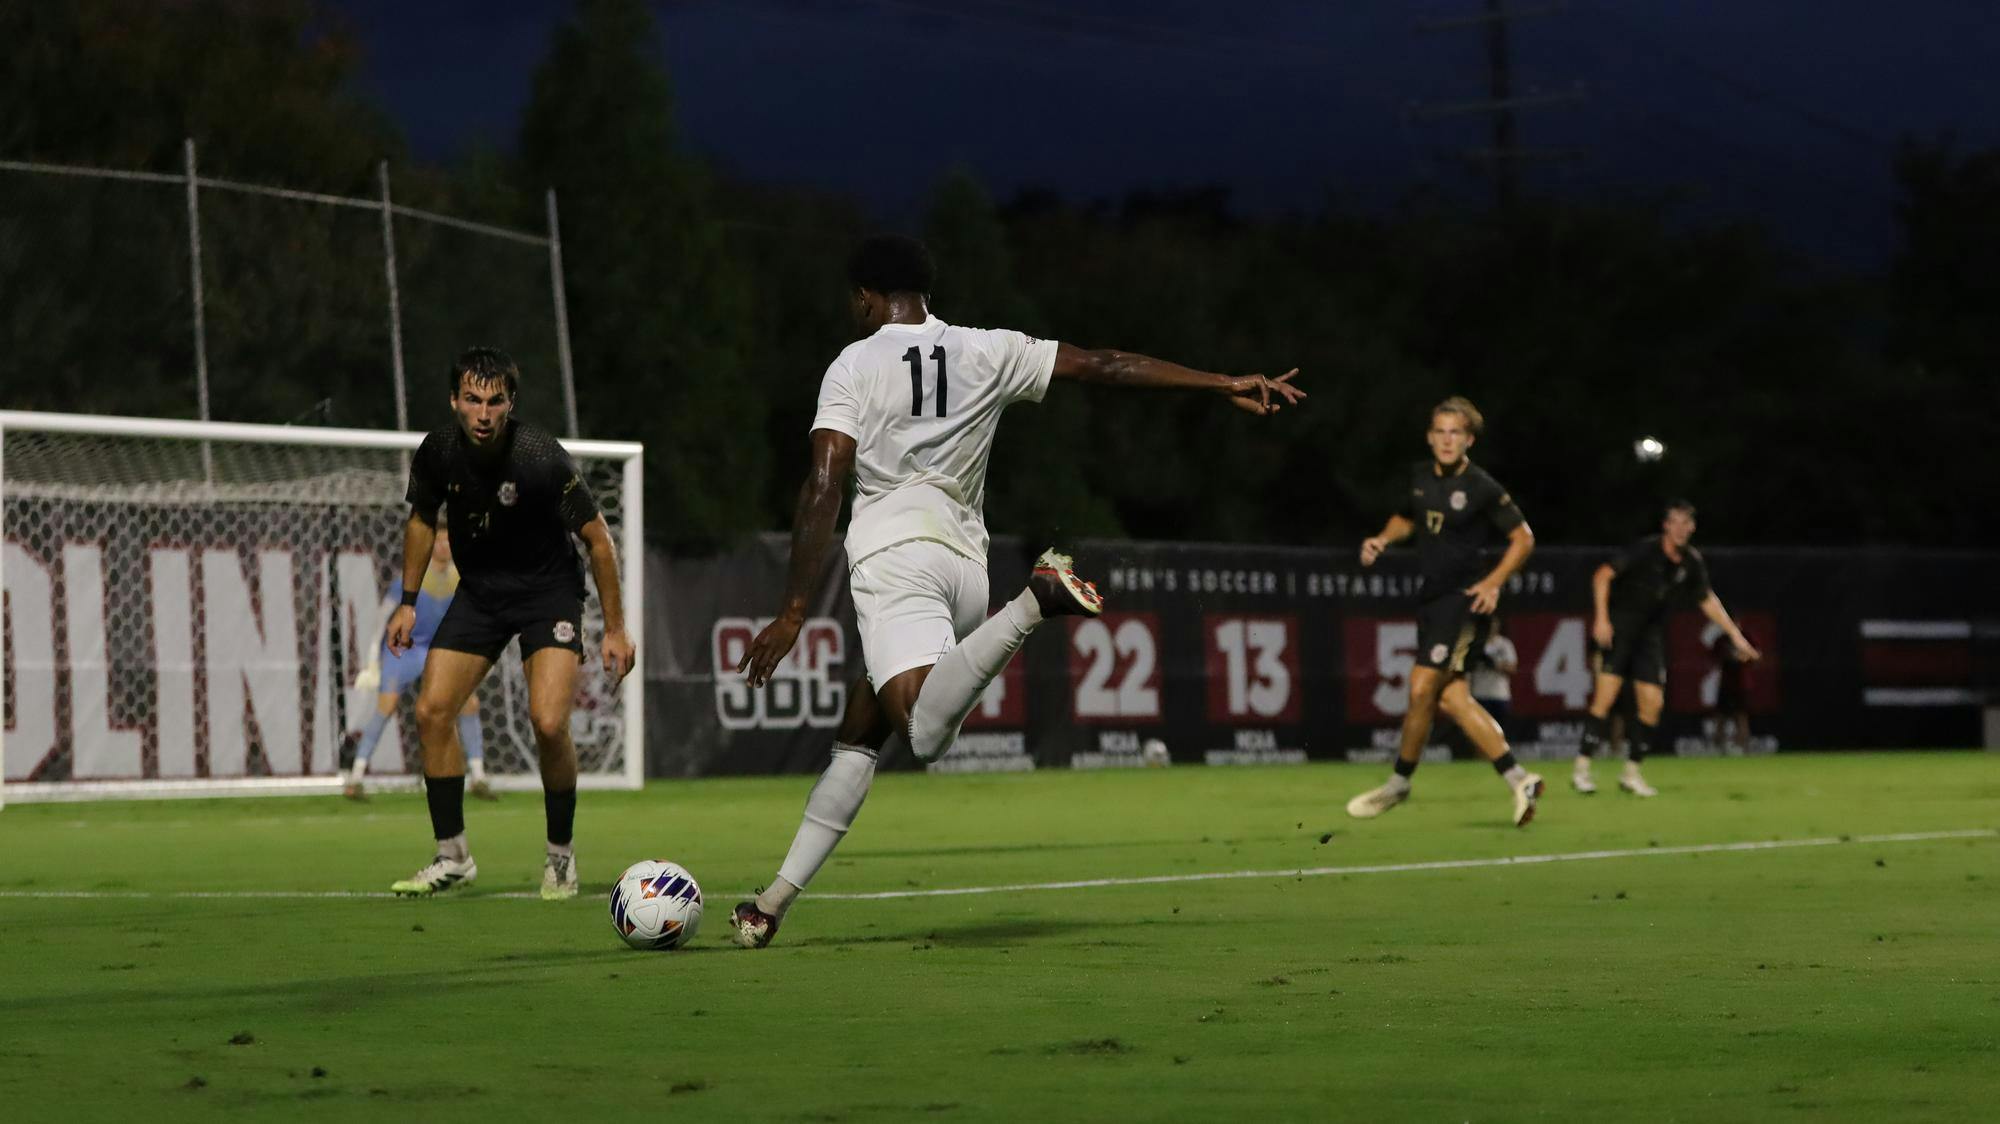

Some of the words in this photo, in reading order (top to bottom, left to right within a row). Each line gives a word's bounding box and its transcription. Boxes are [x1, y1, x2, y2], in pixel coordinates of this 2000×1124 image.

[902, 344, 948, 417] 11
[1426, 509, 1445, 535] 17
[1109, 567, 1178, 592] MEN'S
[1187, 568, 1277, 594] SOCCER
[1073, 618, 1161, 717] 22
[1215, 618, 1292, 718] 13
[1372, 621, 1419, 717] 5
[1533, 616, 1592, 711] 4
